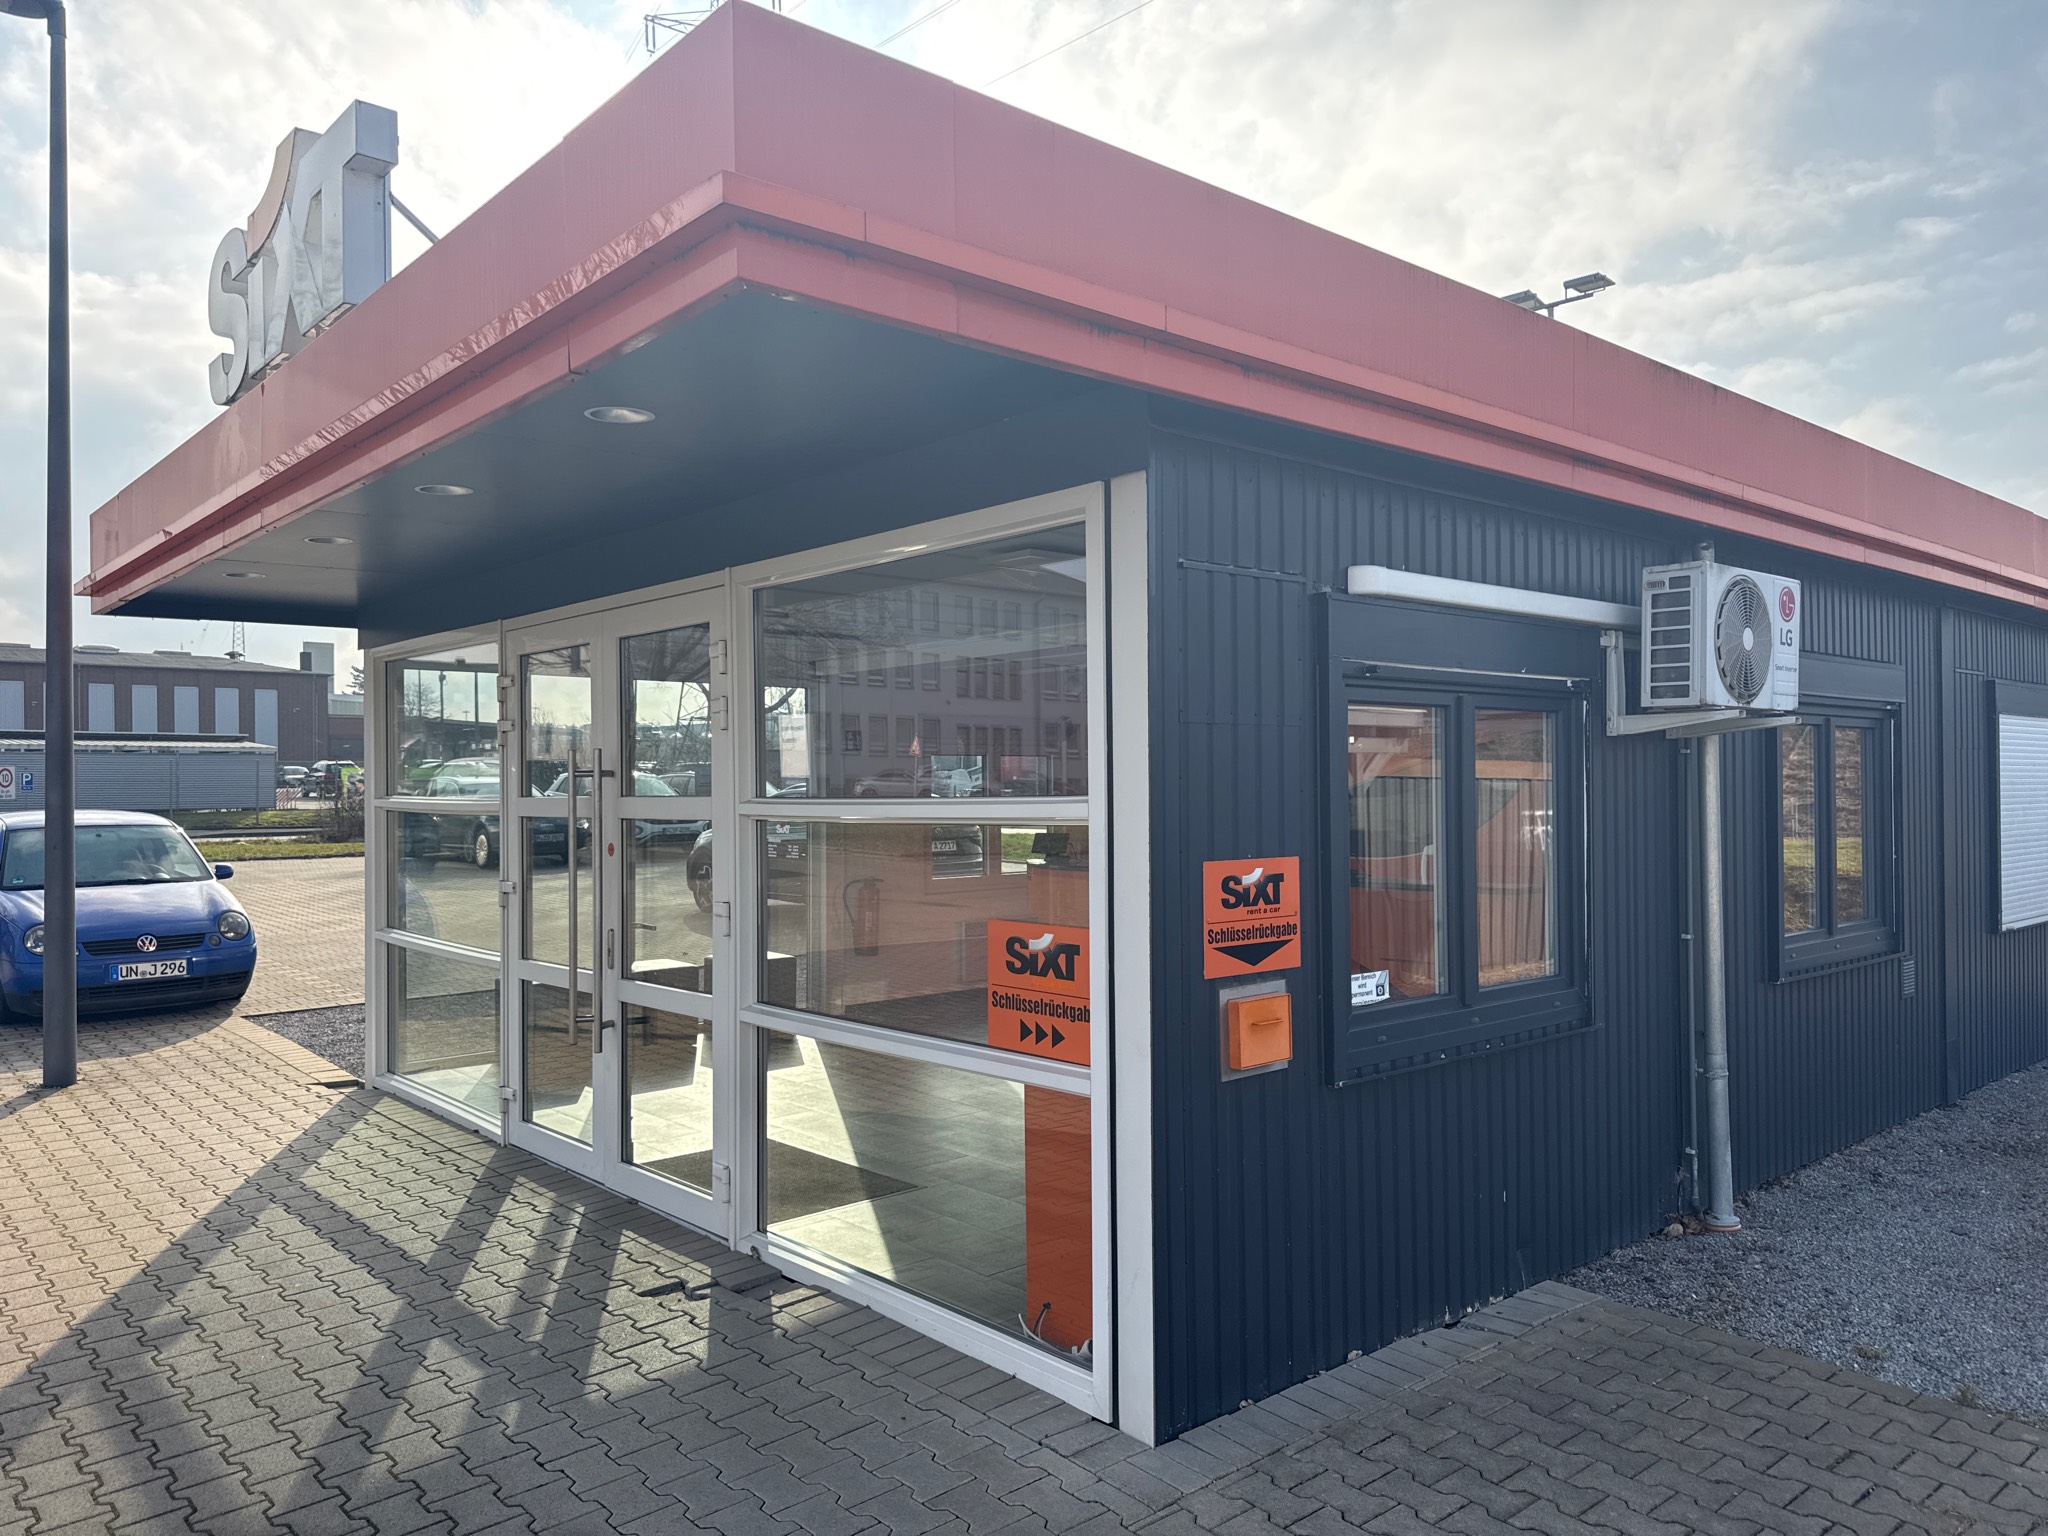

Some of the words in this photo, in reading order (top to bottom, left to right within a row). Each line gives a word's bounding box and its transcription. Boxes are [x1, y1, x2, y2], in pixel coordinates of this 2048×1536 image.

[1780, 628, 1792, 647] LG
[1, 773, 10, 783] 10
[23, 773, 31, 785] P
[1208, 922, 1297, 945] Schlüsselrückgabe
[120, 965, 138, 979] UN
[149, 964, 157, 976] J
[160, 962, 186, 976] 296
[992, 990, 1090, 1023] Schlüsselrückgab
